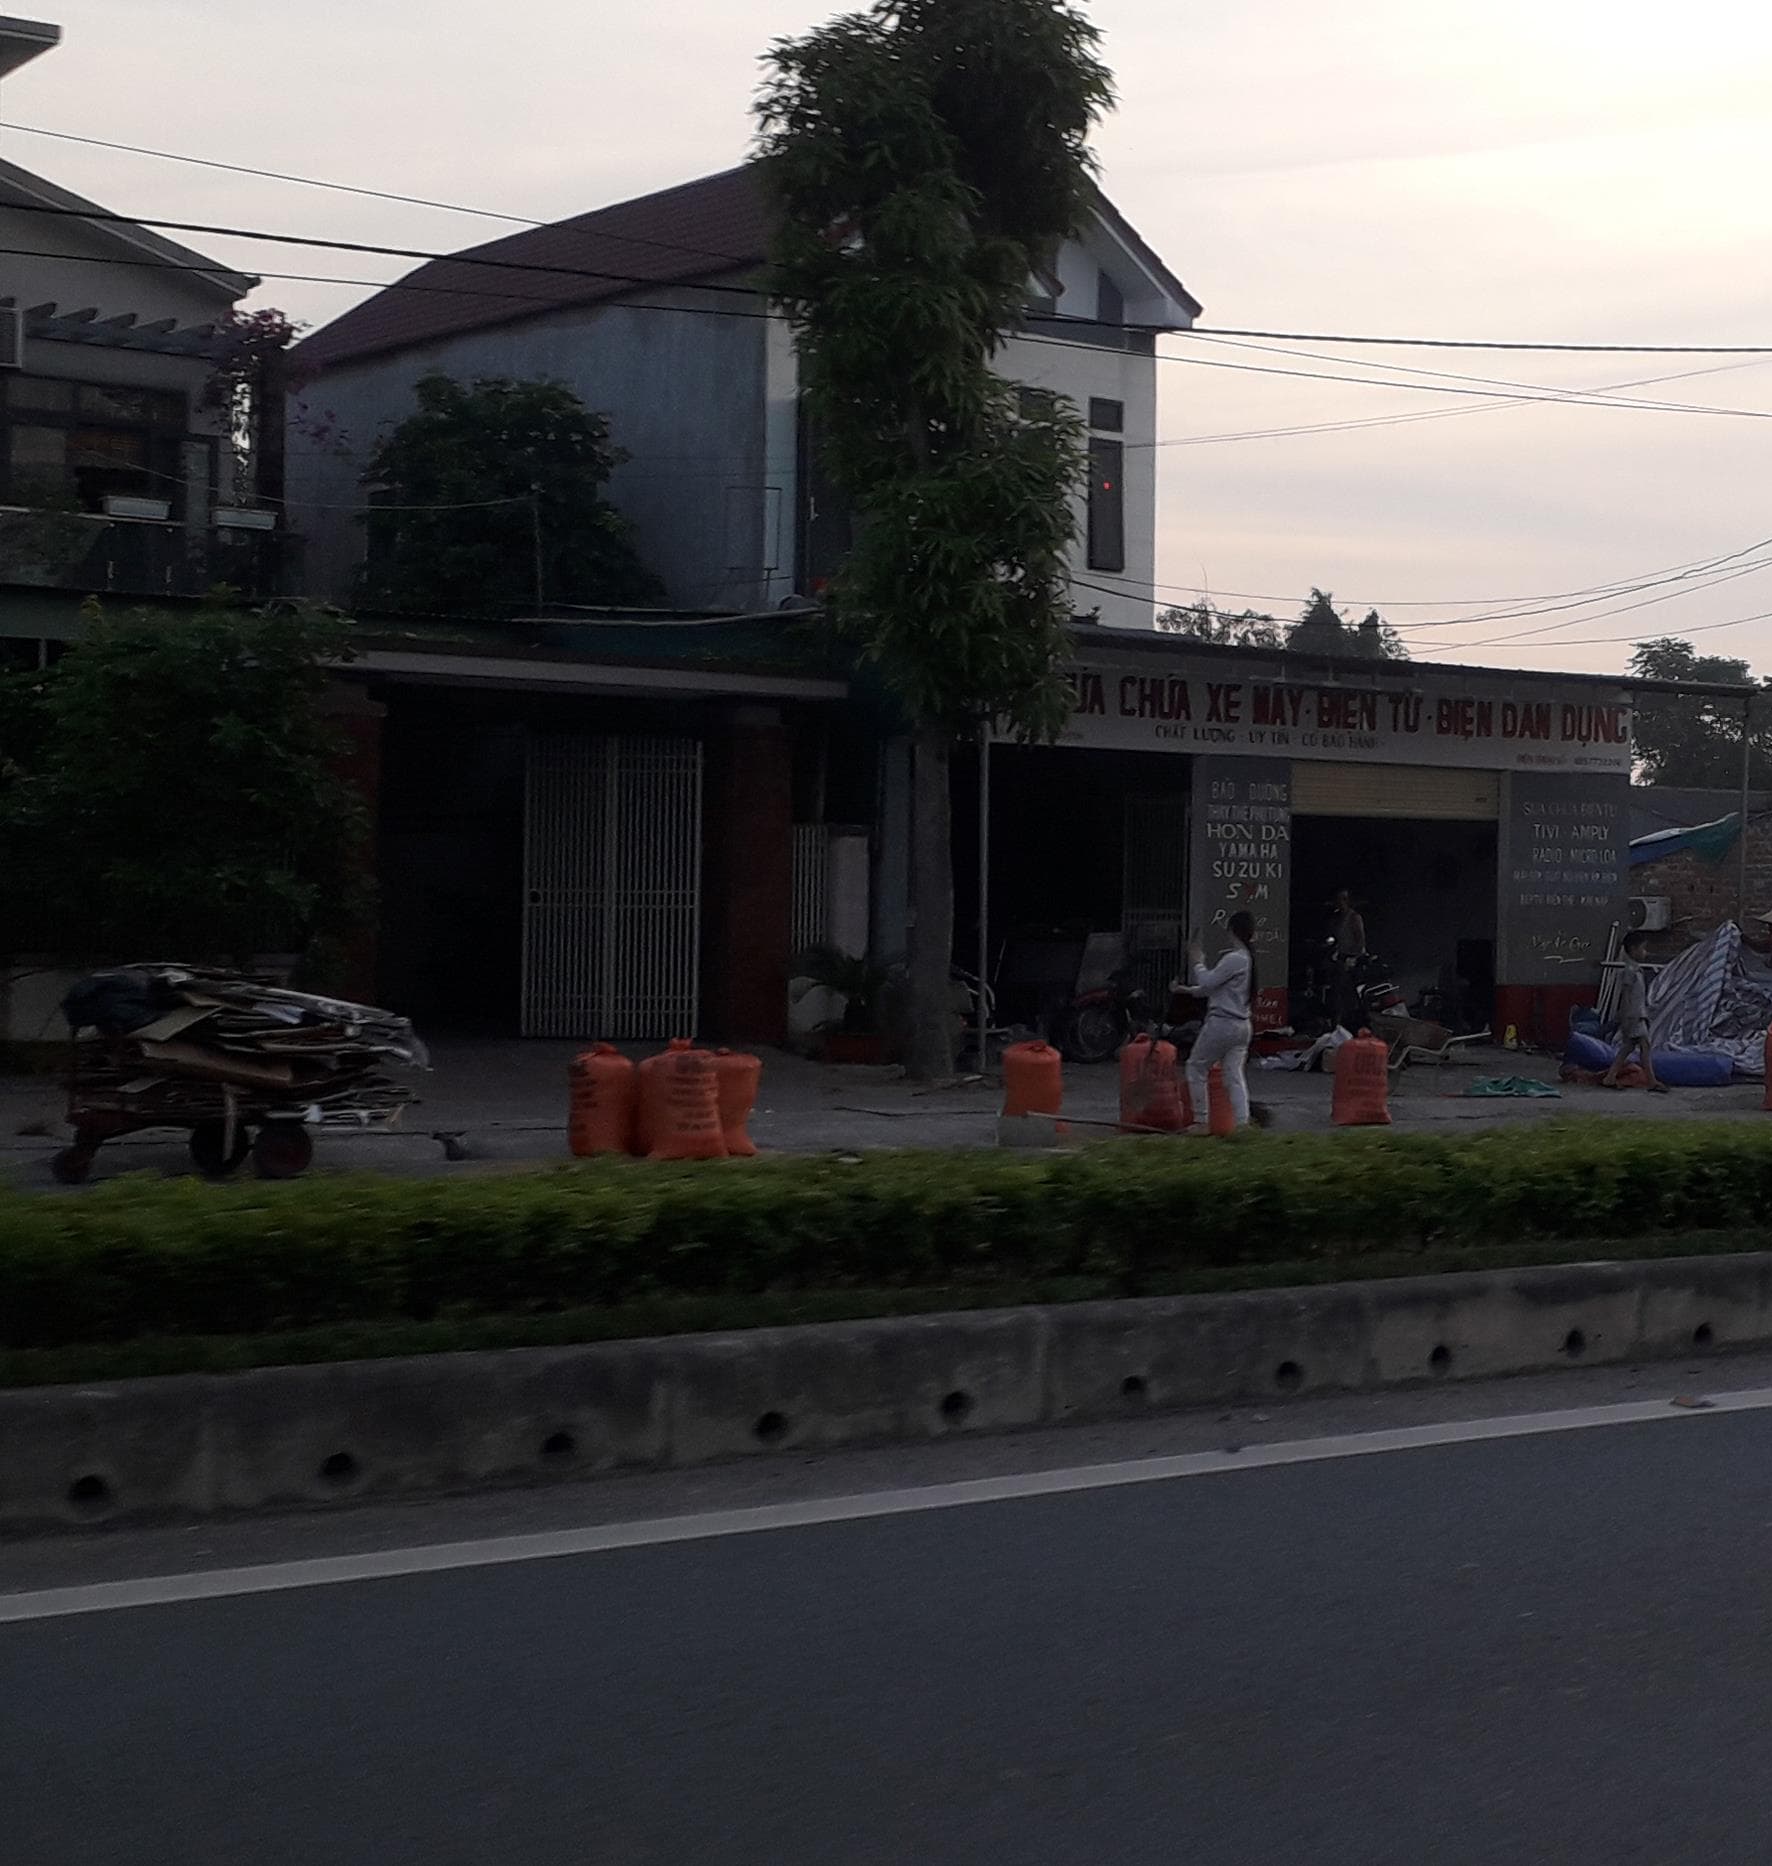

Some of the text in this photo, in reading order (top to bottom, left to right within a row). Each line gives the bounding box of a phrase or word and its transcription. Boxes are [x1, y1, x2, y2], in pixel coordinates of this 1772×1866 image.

[1207, 683, 1242, 723] XE
[1561, 703, 1629, 747] DỤNG
[1570, 824, 1610, 841] AMPLY
